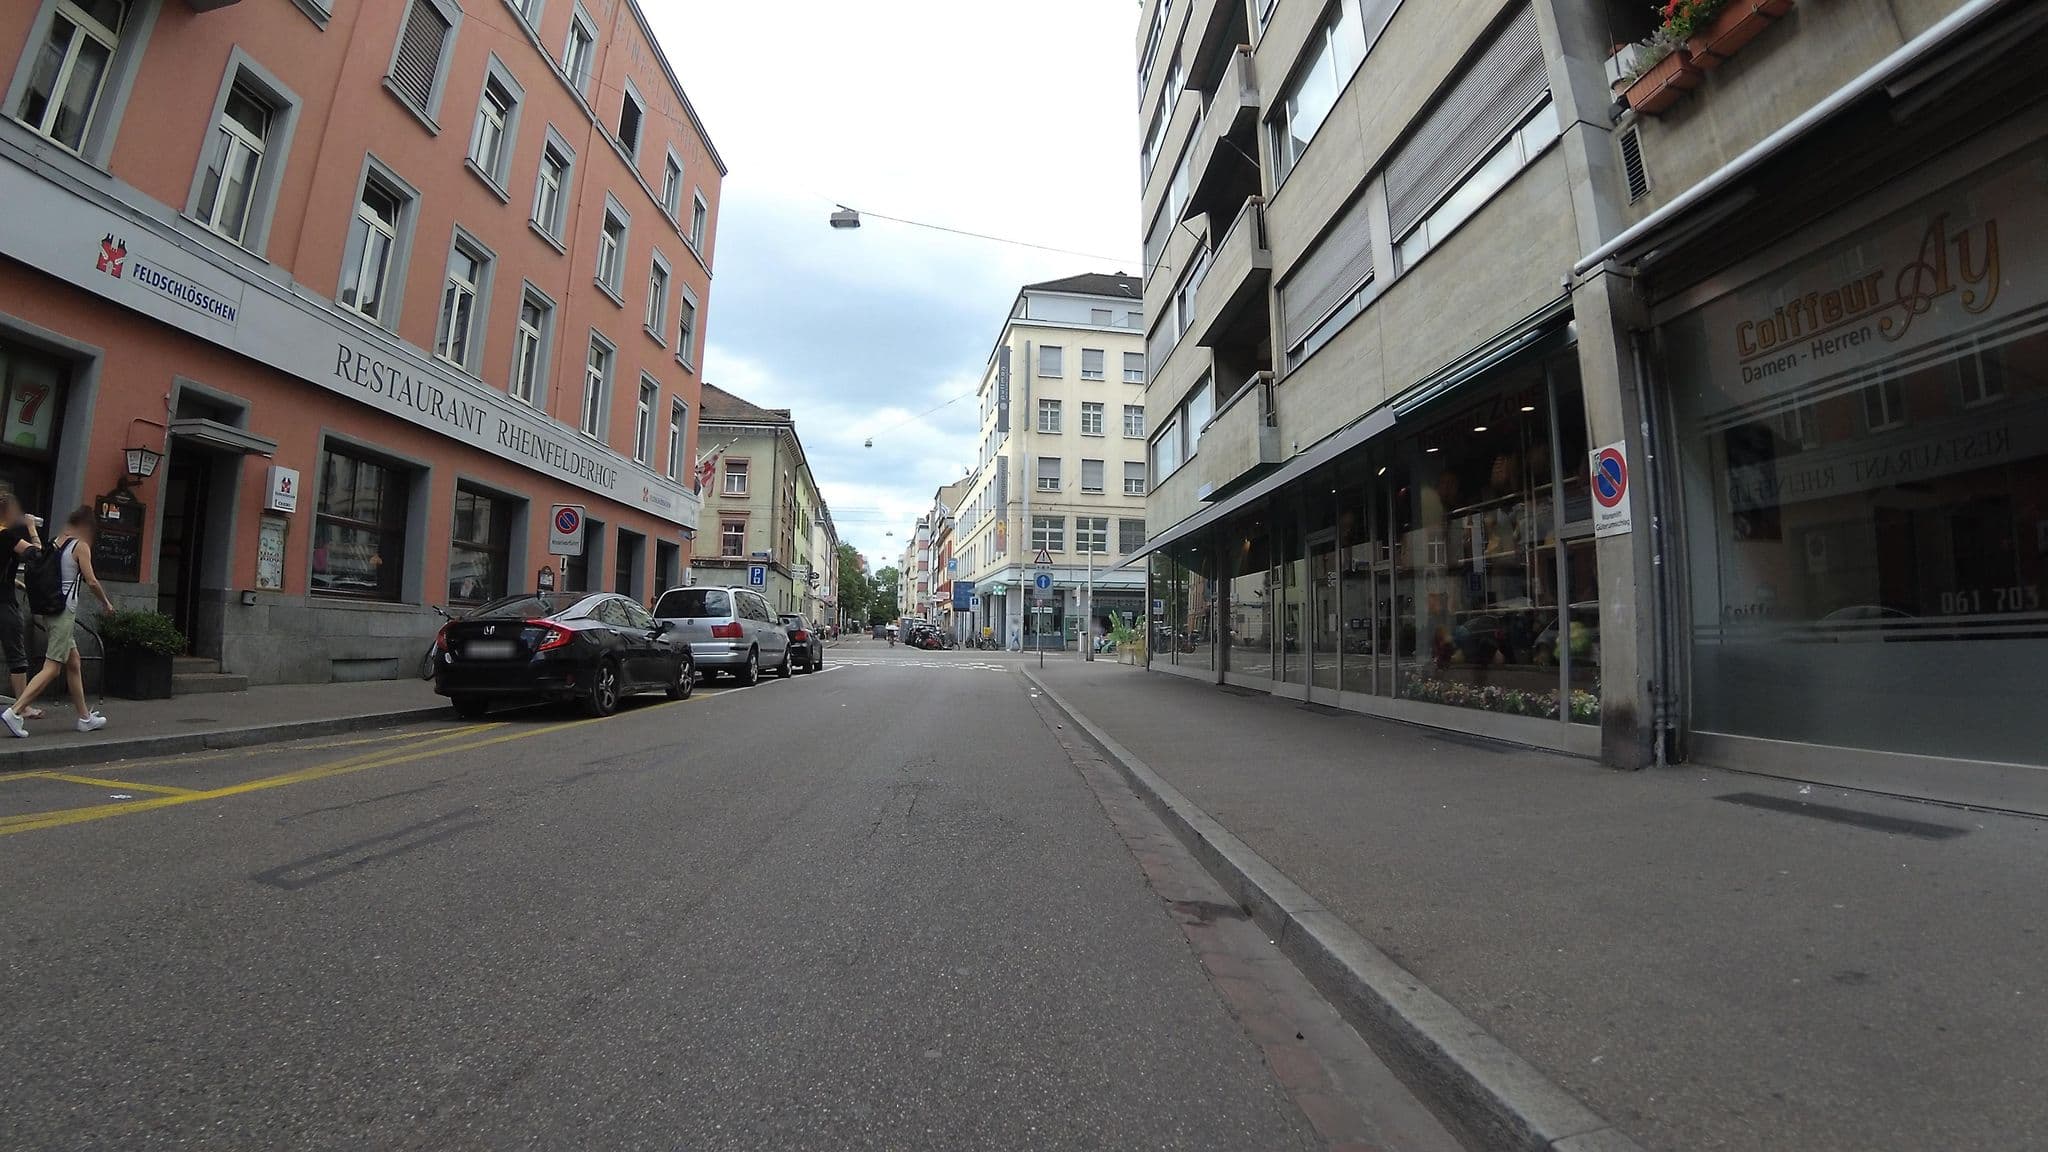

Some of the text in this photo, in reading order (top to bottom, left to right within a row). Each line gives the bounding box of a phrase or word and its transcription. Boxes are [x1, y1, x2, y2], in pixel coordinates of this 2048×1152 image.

[133, 263, 236, 322] FELDSCHLÖSSCHEN
[1736, 213, 2001, 353] Coiffeur Ay
[1741, 353, 1797, 385] Damen
[1811, 327, 1872, 359] Herren
[15, 384, 50, 426] 7
[334, 343, 618, 490] RESTAURANT RHEINFELDERHOF
[754, 568, 761, 577] P
[1941, 589, 1980, 614] 061
